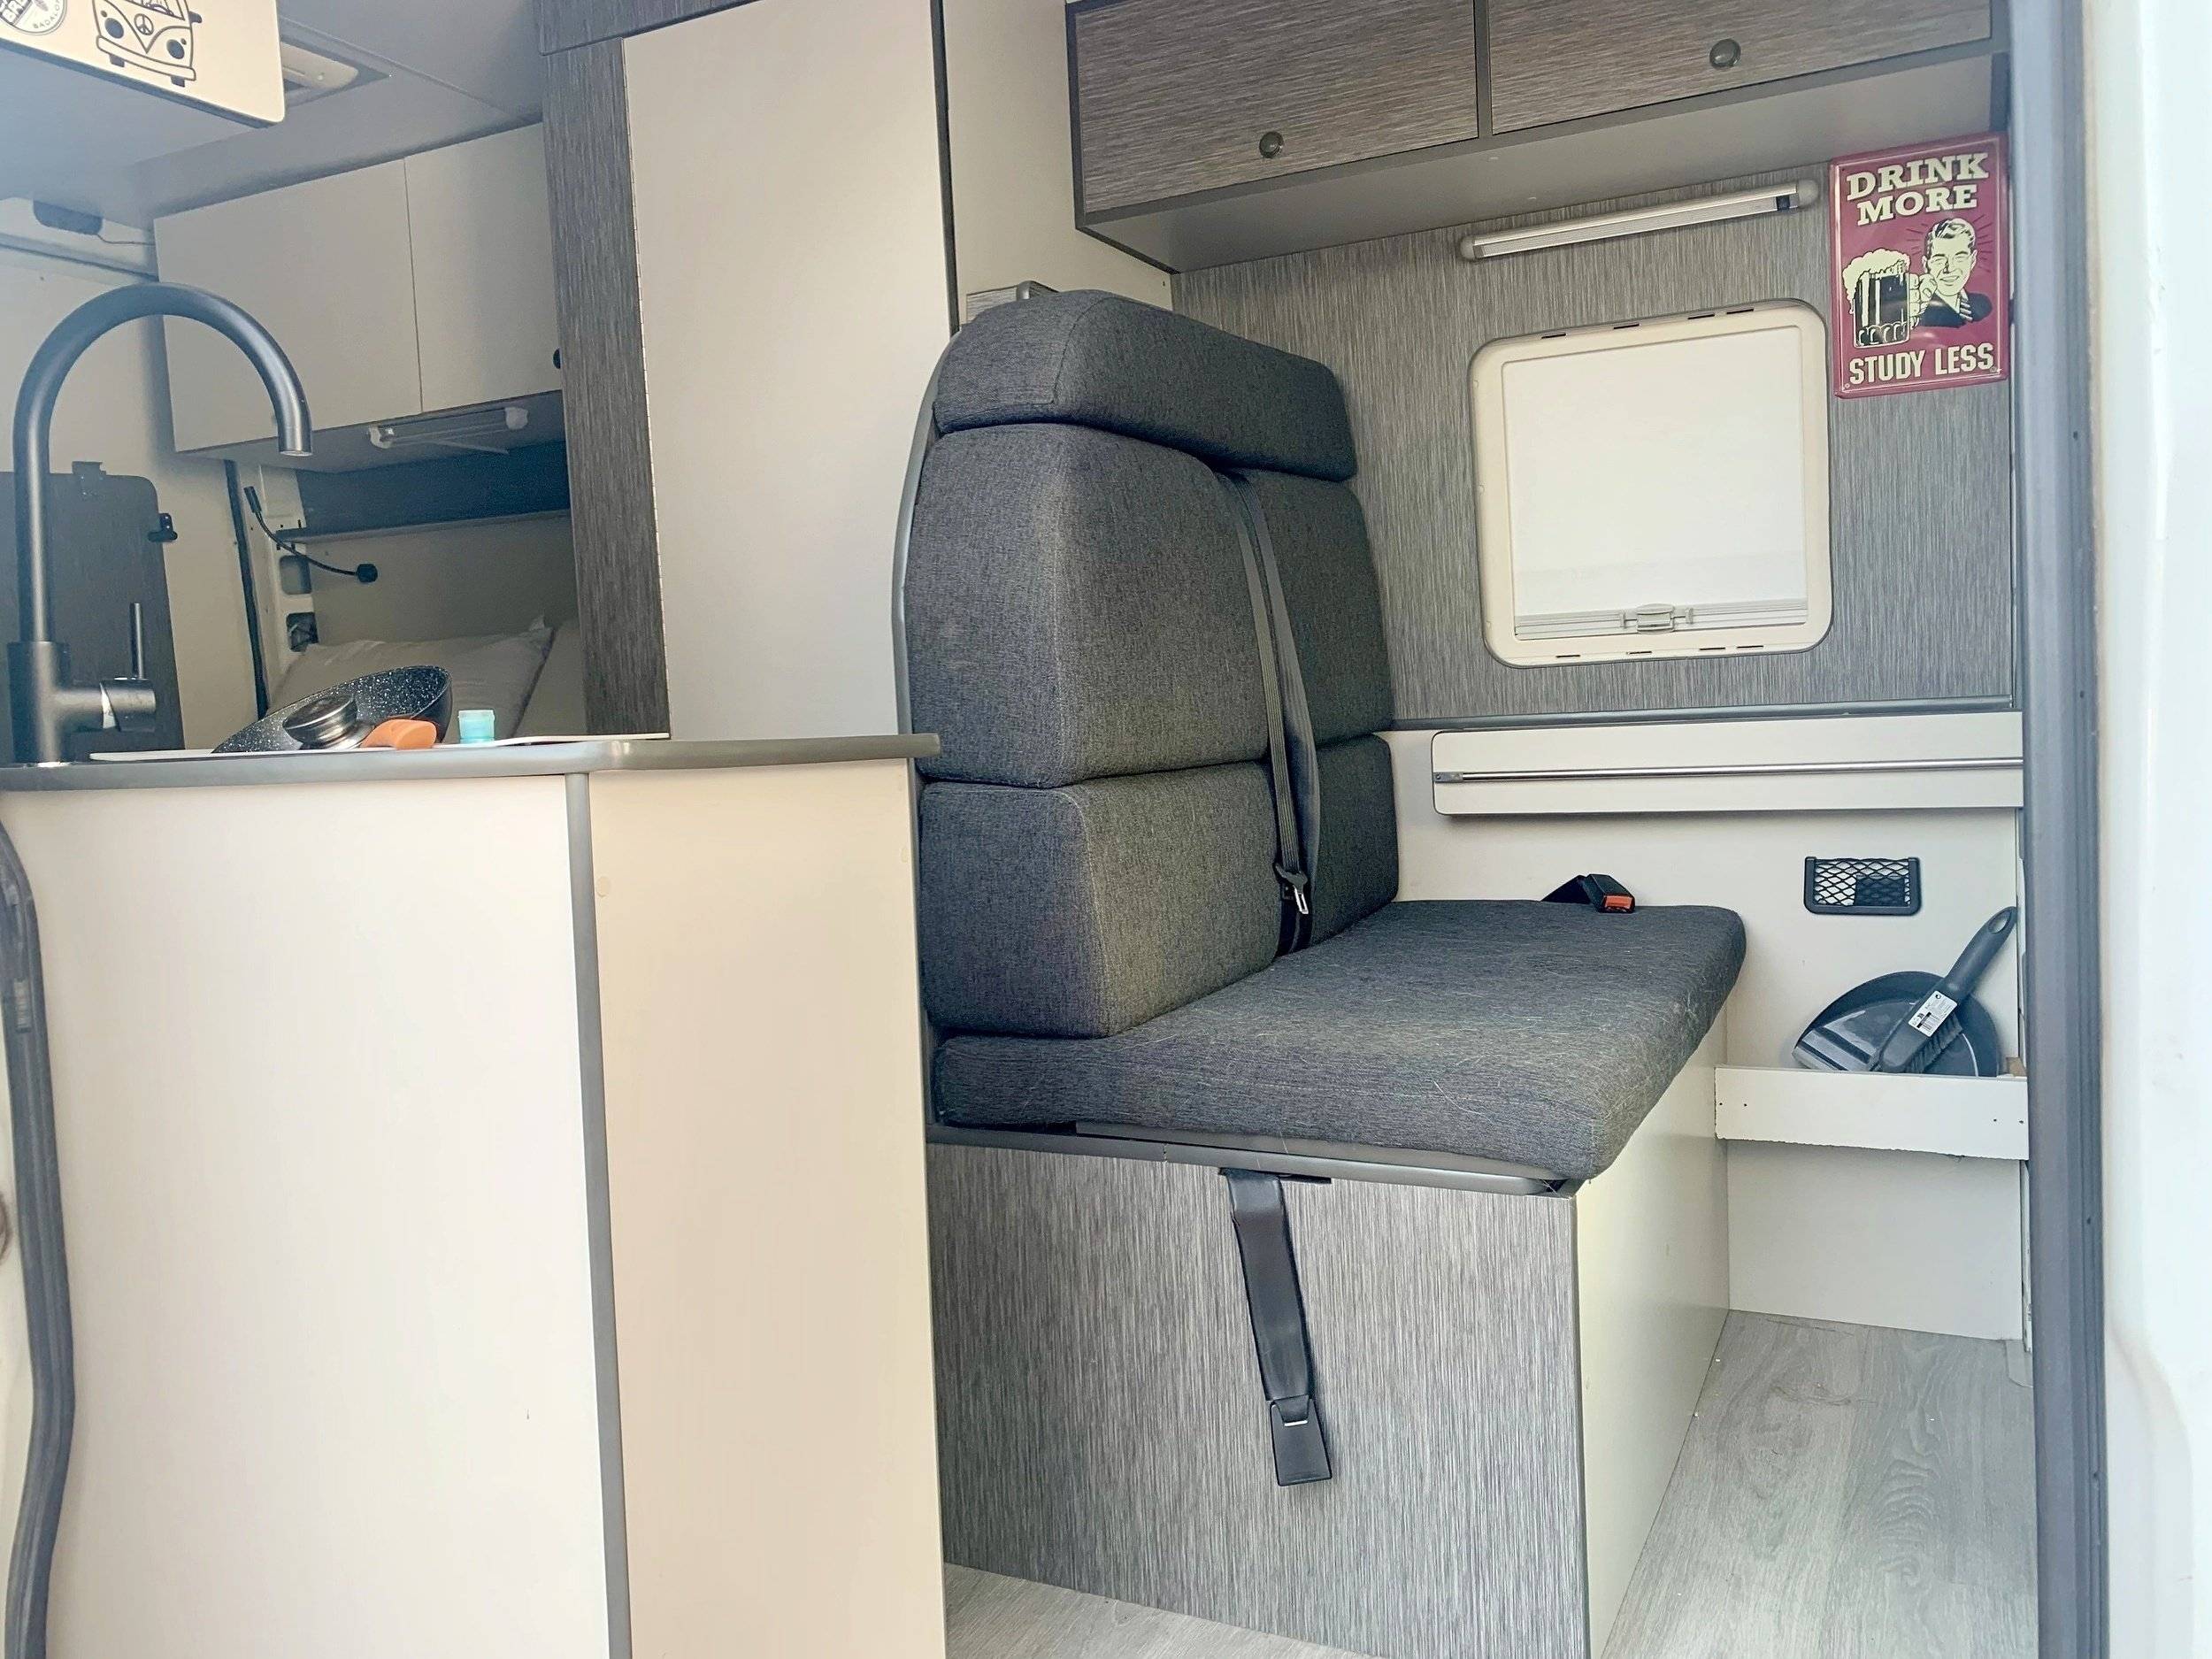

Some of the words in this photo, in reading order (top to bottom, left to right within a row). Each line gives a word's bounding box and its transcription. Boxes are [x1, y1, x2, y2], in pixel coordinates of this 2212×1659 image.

[1846, 152, 1989, 201] DRINK
[1856, 184, 1978, 227] MORE
[1849, 349, 1925, 385] STUDY
[1935, 342, 1993, 375] LESS
